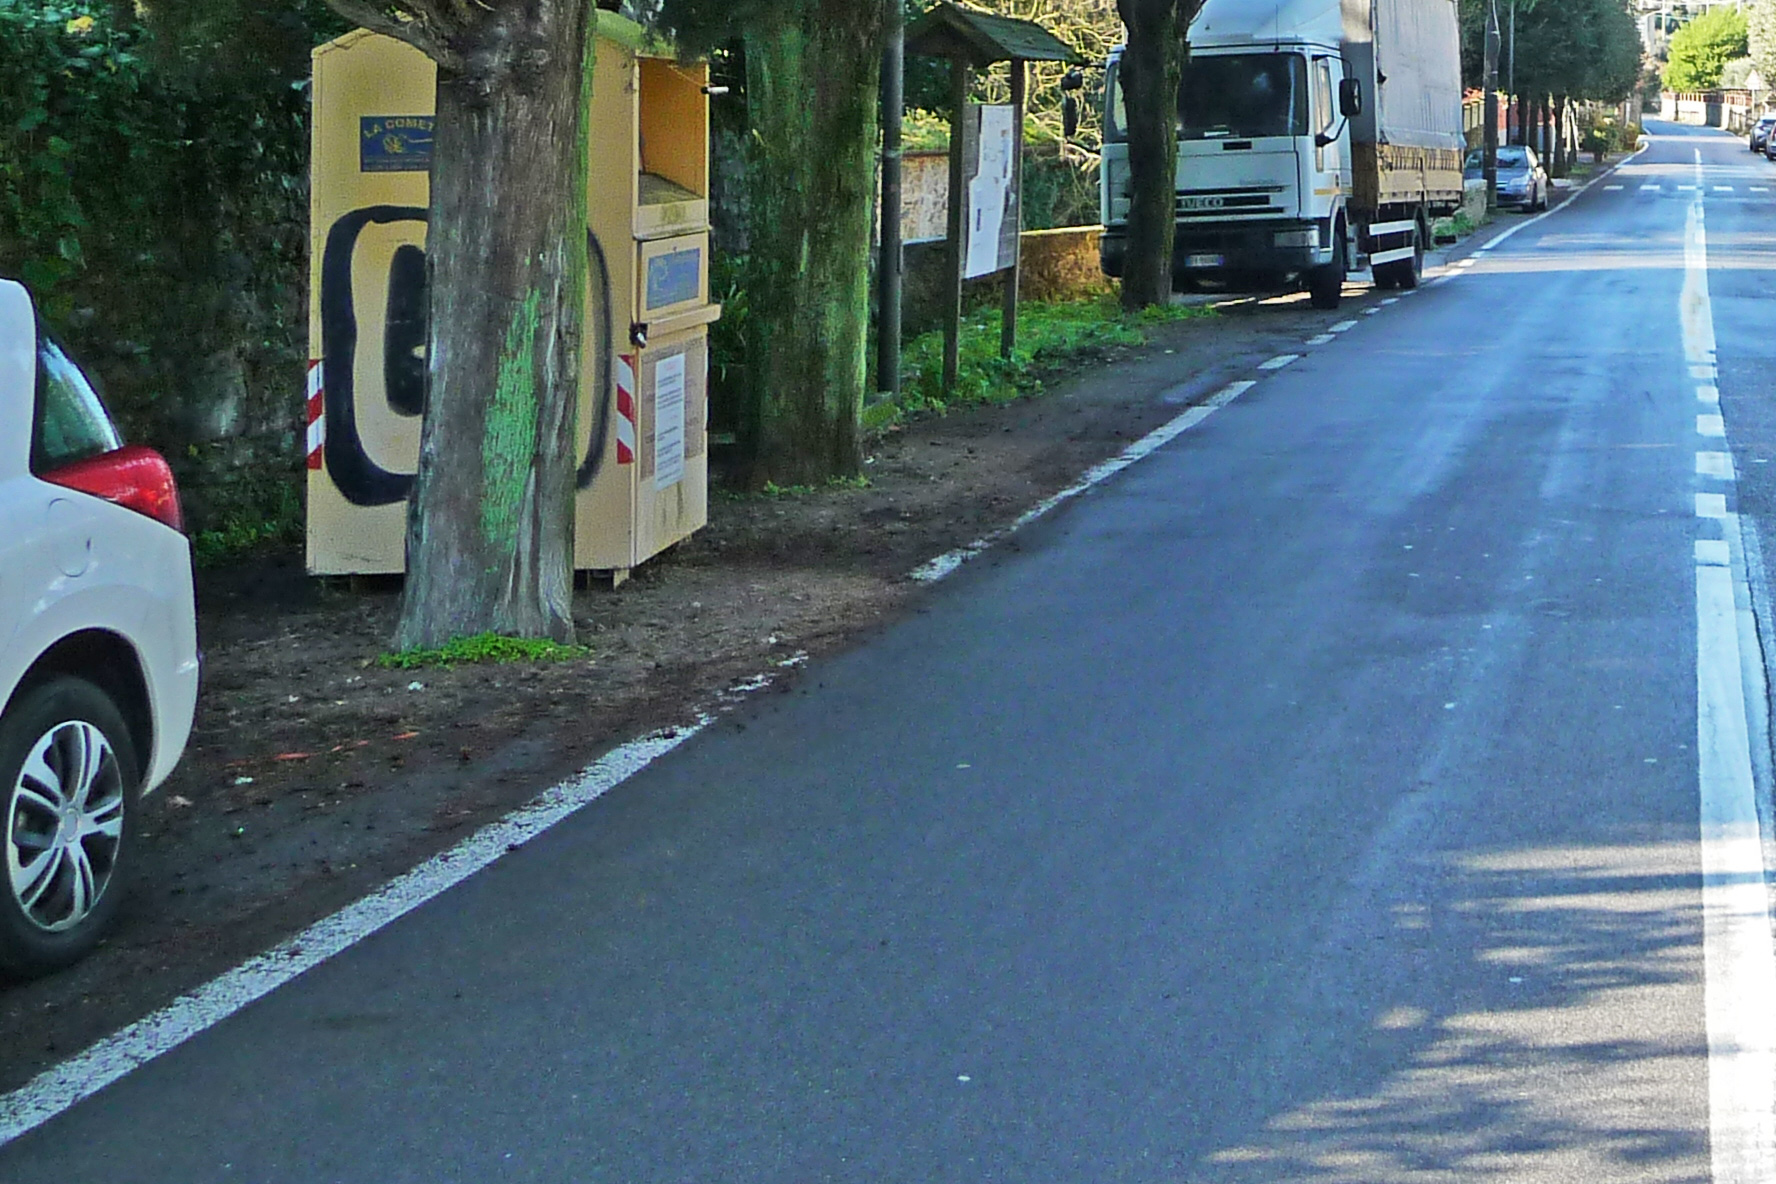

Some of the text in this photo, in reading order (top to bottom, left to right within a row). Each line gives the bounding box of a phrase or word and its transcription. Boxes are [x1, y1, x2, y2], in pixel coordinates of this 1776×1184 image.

[363, 118, 434, 138] LA COMET
[1181, 197, 1224, 209] IVECO
